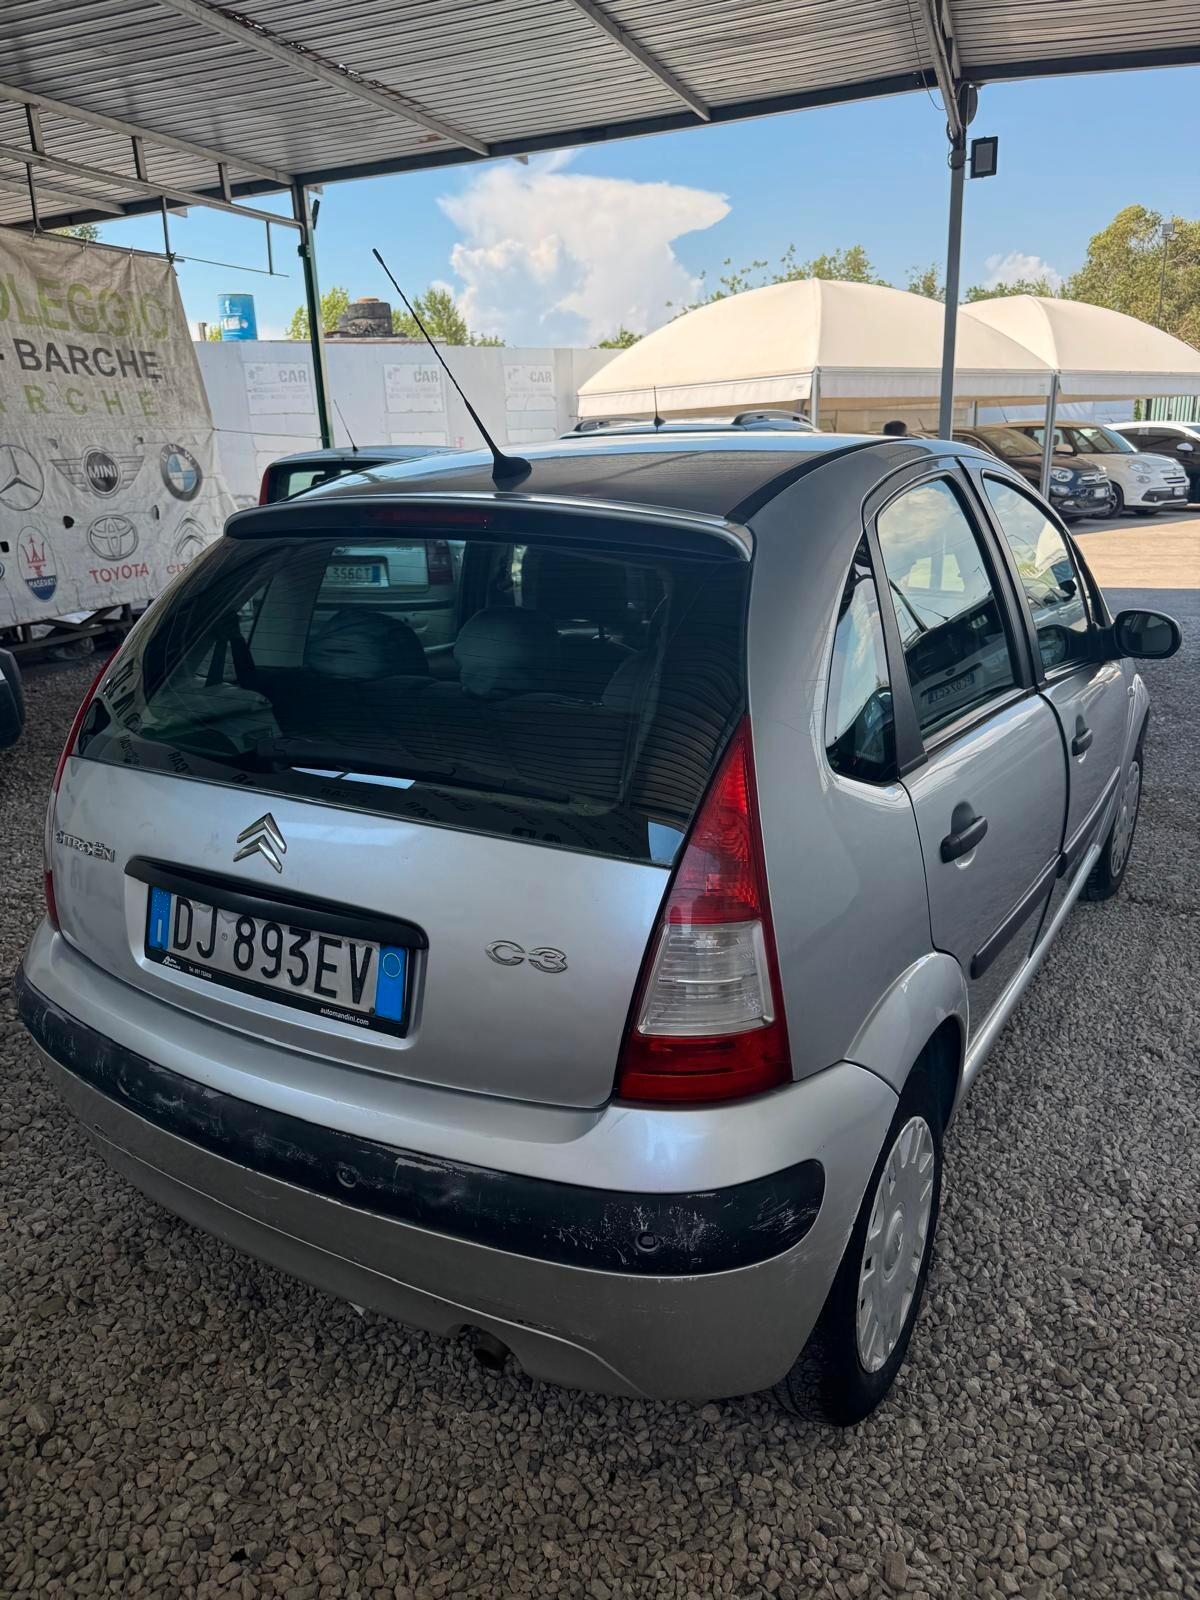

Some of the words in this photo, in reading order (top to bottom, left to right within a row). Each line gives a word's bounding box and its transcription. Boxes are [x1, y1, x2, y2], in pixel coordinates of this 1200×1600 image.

[12, 337, 163, 381] BARCHE
[279, 369, 307, 383] CAR
[414, 370, 439, 383] CAR
[529, 371, 552, 384] CAR
[160, 443, 194, 463] BMW
[87, 464, 118, 480] MINI
[88, 563, 150, 585] TOYOTA
[55, 829, 116, 863] CITROËN
[172, 895, 218, 960] DJ
[232, 914, 373, 1006] 893EV
[484, 939, 569, 974] C3
[319, 1005, 370, 1027] automandini.com
